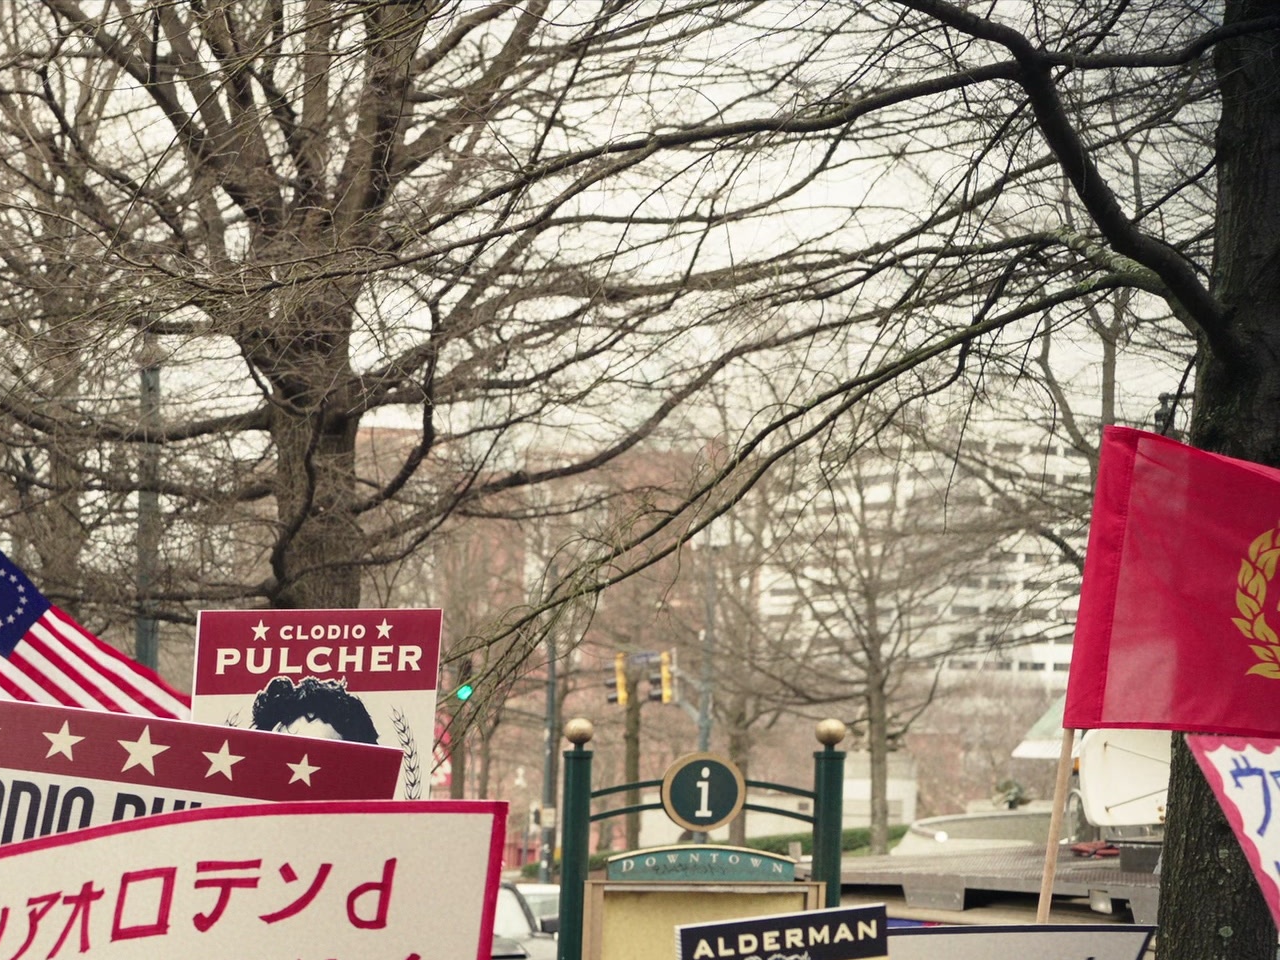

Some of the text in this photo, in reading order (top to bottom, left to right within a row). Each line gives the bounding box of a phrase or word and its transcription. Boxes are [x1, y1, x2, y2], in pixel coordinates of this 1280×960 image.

[279, 623, 366, 641] CLODIO
[214, 644, 423, 675] PULCHER
[621, 852, 784, 874] DOWNTOWN
[693, 918, 879, 960] ALDERMAN
